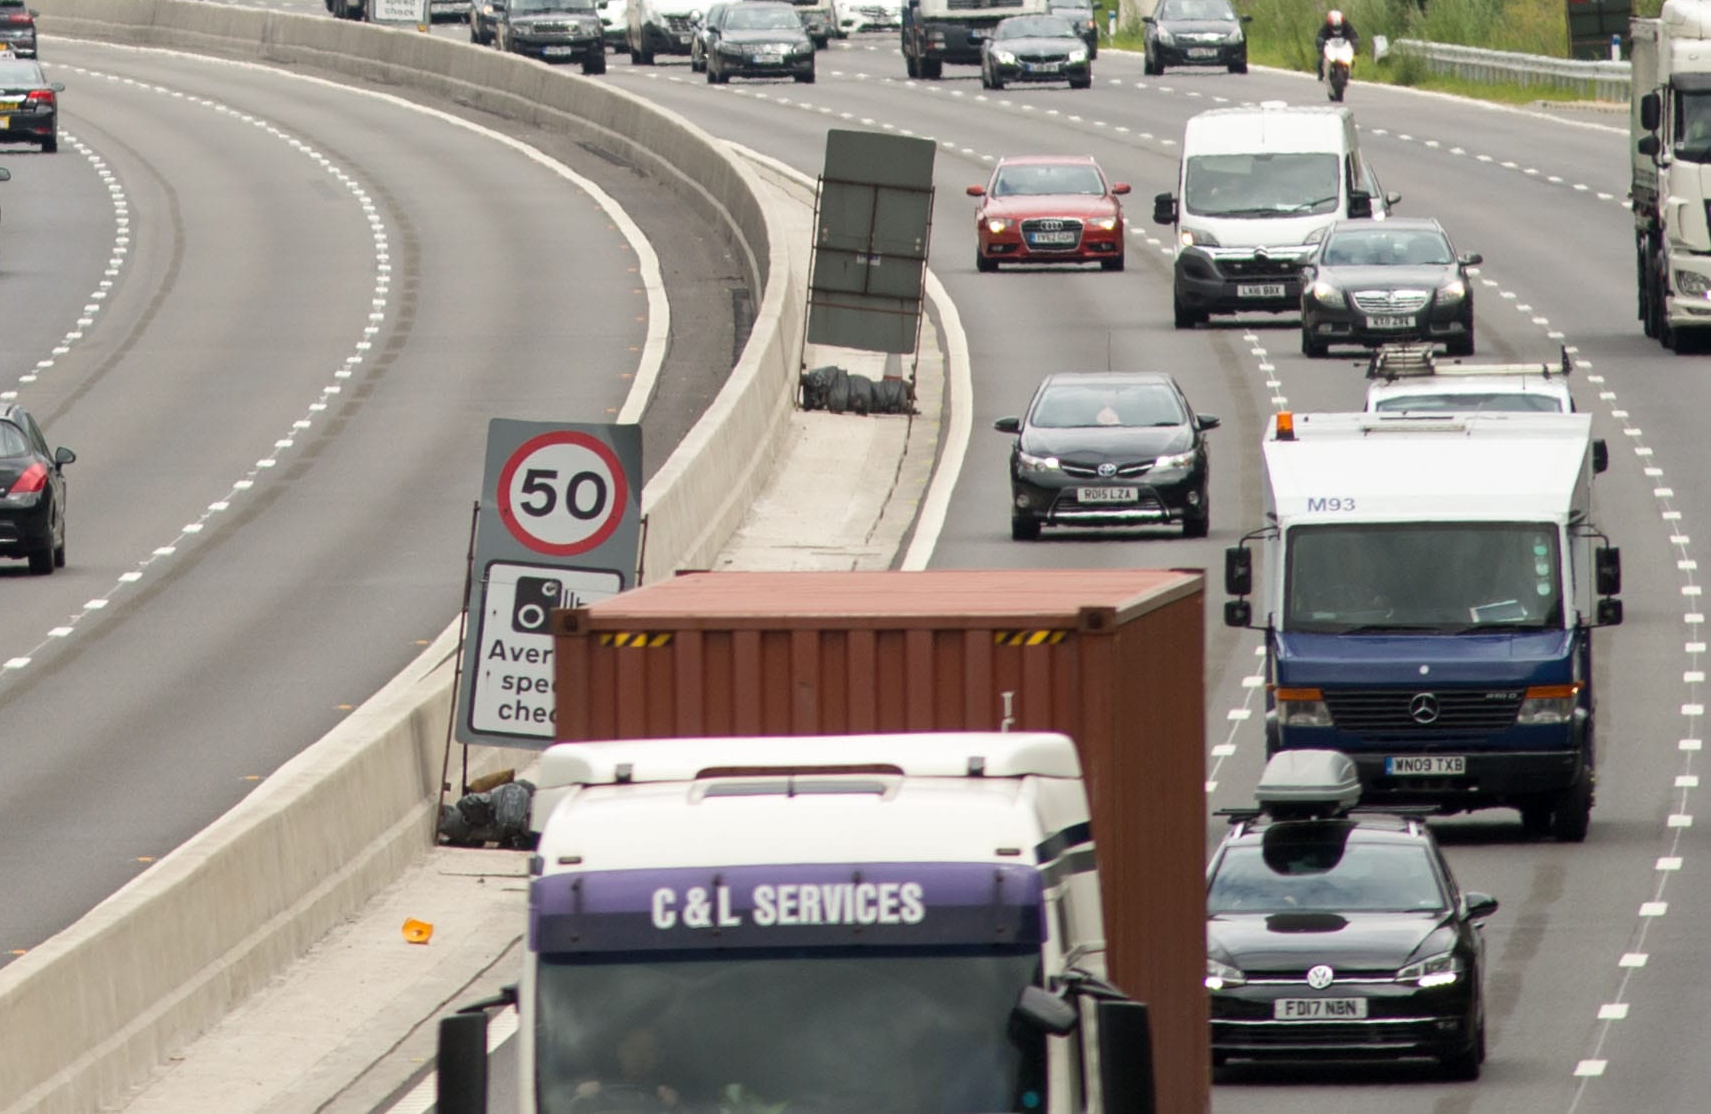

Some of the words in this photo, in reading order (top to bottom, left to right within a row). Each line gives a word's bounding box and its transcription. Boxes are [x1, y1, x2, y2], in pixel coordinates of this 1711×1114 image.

[519, 468, 607, 521] 50
[1110, 489, 1131, 499] LZA
[1307, 497, 1357, 513] M93
[488, 639, 553, 664] Aver
[501, 674, 556, 696] spe
[1395, 759, 1433, 772] WN09
[1437, 759, 1463, 771] TXB
[753, 882, 925, 926] SERVICES
[1285, 1000, 1321, 1016] FD17
